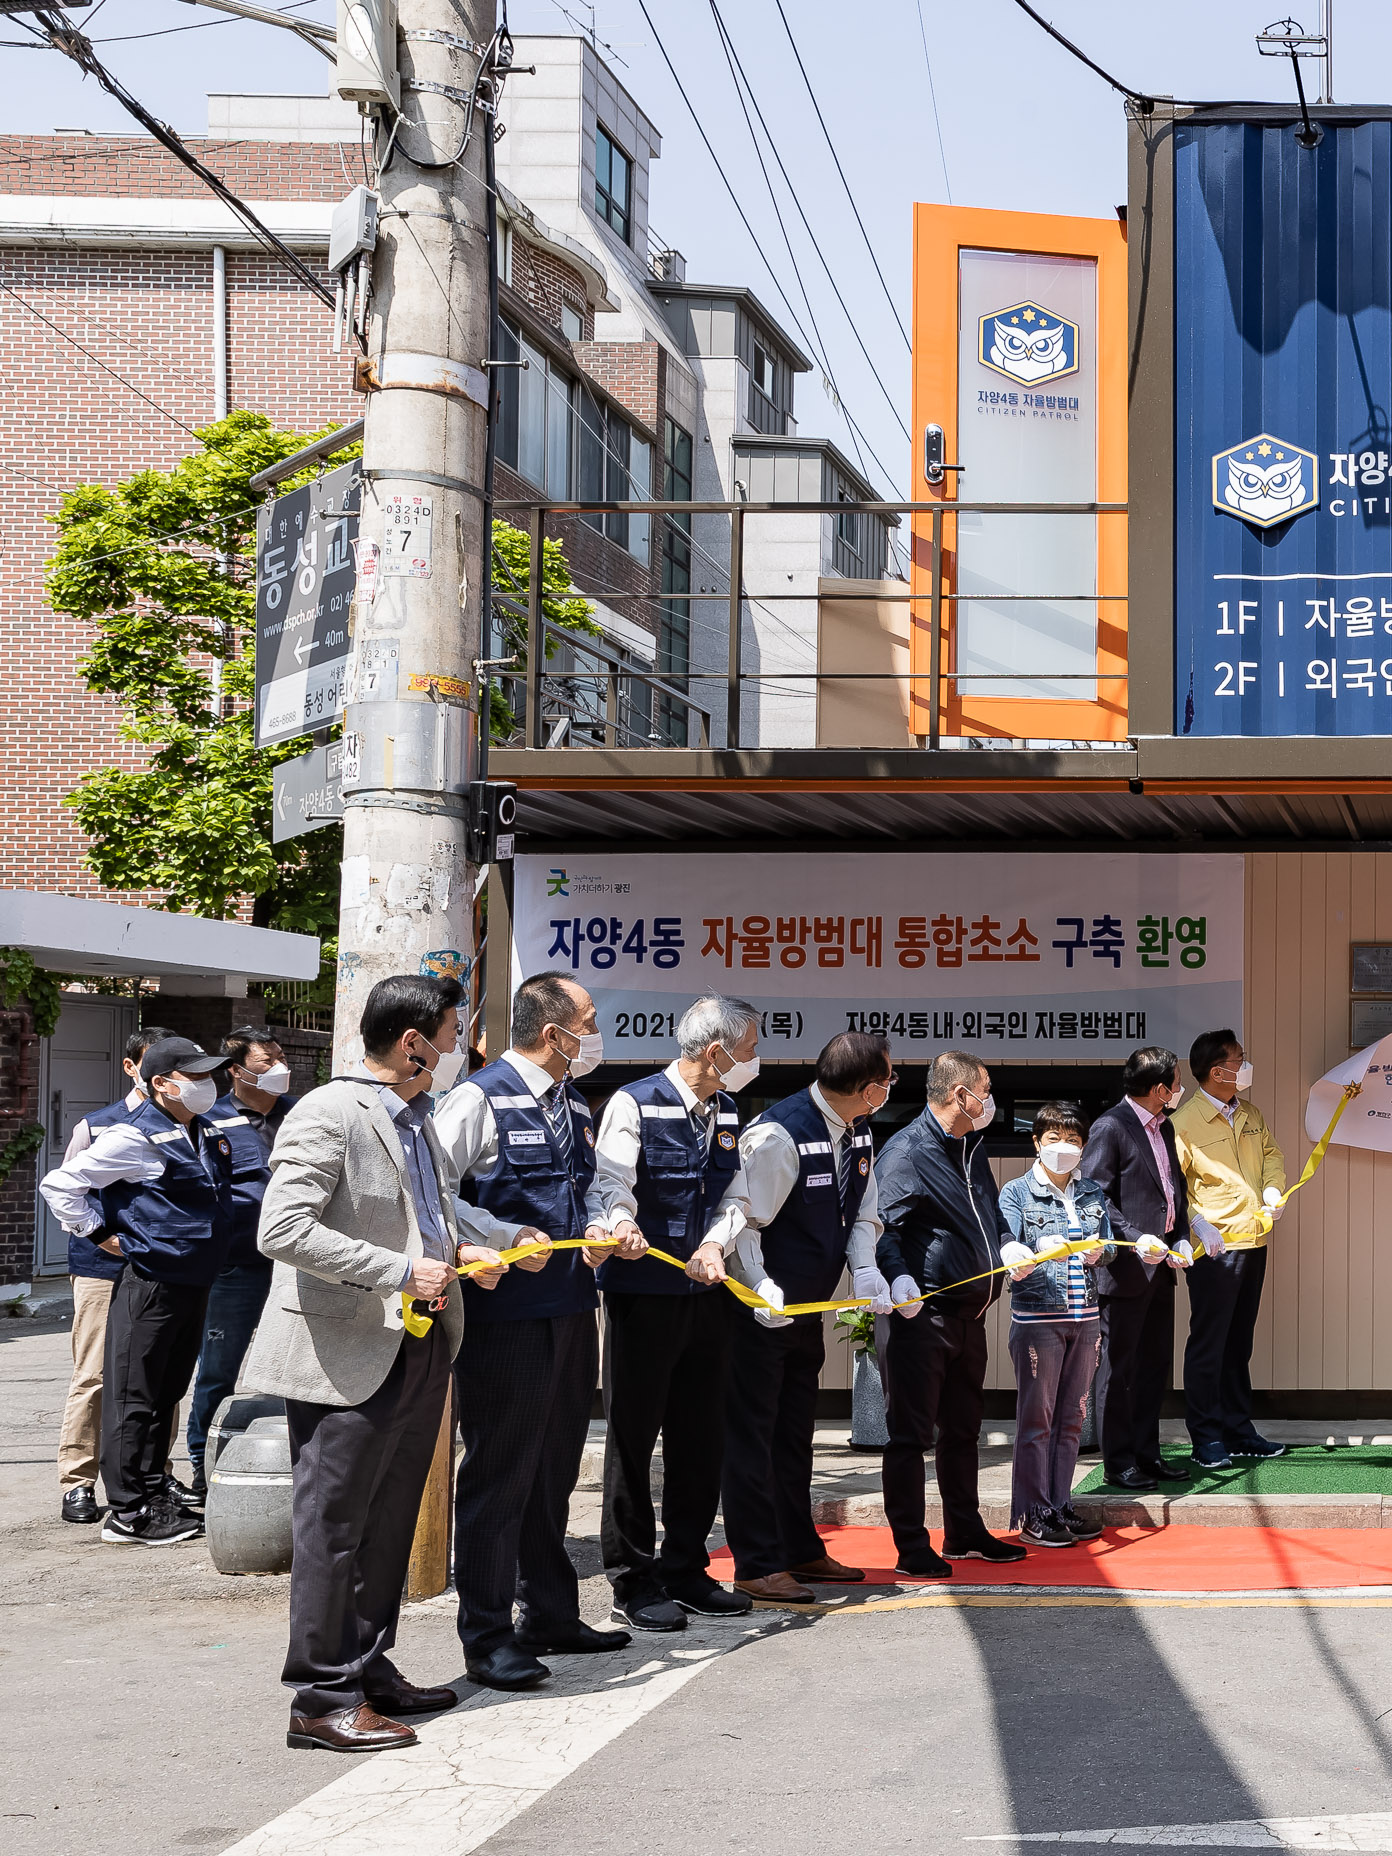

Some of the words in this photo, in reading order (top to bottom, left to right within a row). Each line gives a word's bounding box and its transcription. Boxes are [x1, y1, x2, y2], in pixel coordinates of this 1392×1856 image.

[977, 390, 1019, 405] 자양4동
[1022, 393, 1079, 411] 자율방범대
[977, 406, 1026, 417] CITIZEN
[1032, 410, 1079, 421] PATROL
[386, 504, 431, 517] 0324D
[395, 516, 418, 525] 891
[400, 530, 412, 552] 7
[263, 602, 325, 639] www.dspch.or.kr
[1215, 600, 1259, 636] 1F
[325, 629, 344, 648] 40m
[368, 673, 377, 689] 7
[1213, 661, 1259, 697] 2F
[304, 688, 325, 717] 동성
[299, 784, 335, 815] 자양4동
[573, 883, 613, 894] 가치더하기
[613, 883, 631, 894] 광진
[546, 915, 686, 970] 자양4동
[700, 914, 882, 970] 자율방범대
[893, 912, 1041, 969] 통합초소
[1051, 914, 1126, 969] 구축
[1135, 914, 1208, 970] 환영
[614, 1011, 676, 1038] 2021
[1034, 1010, 1146, 1040] 자율방범대
